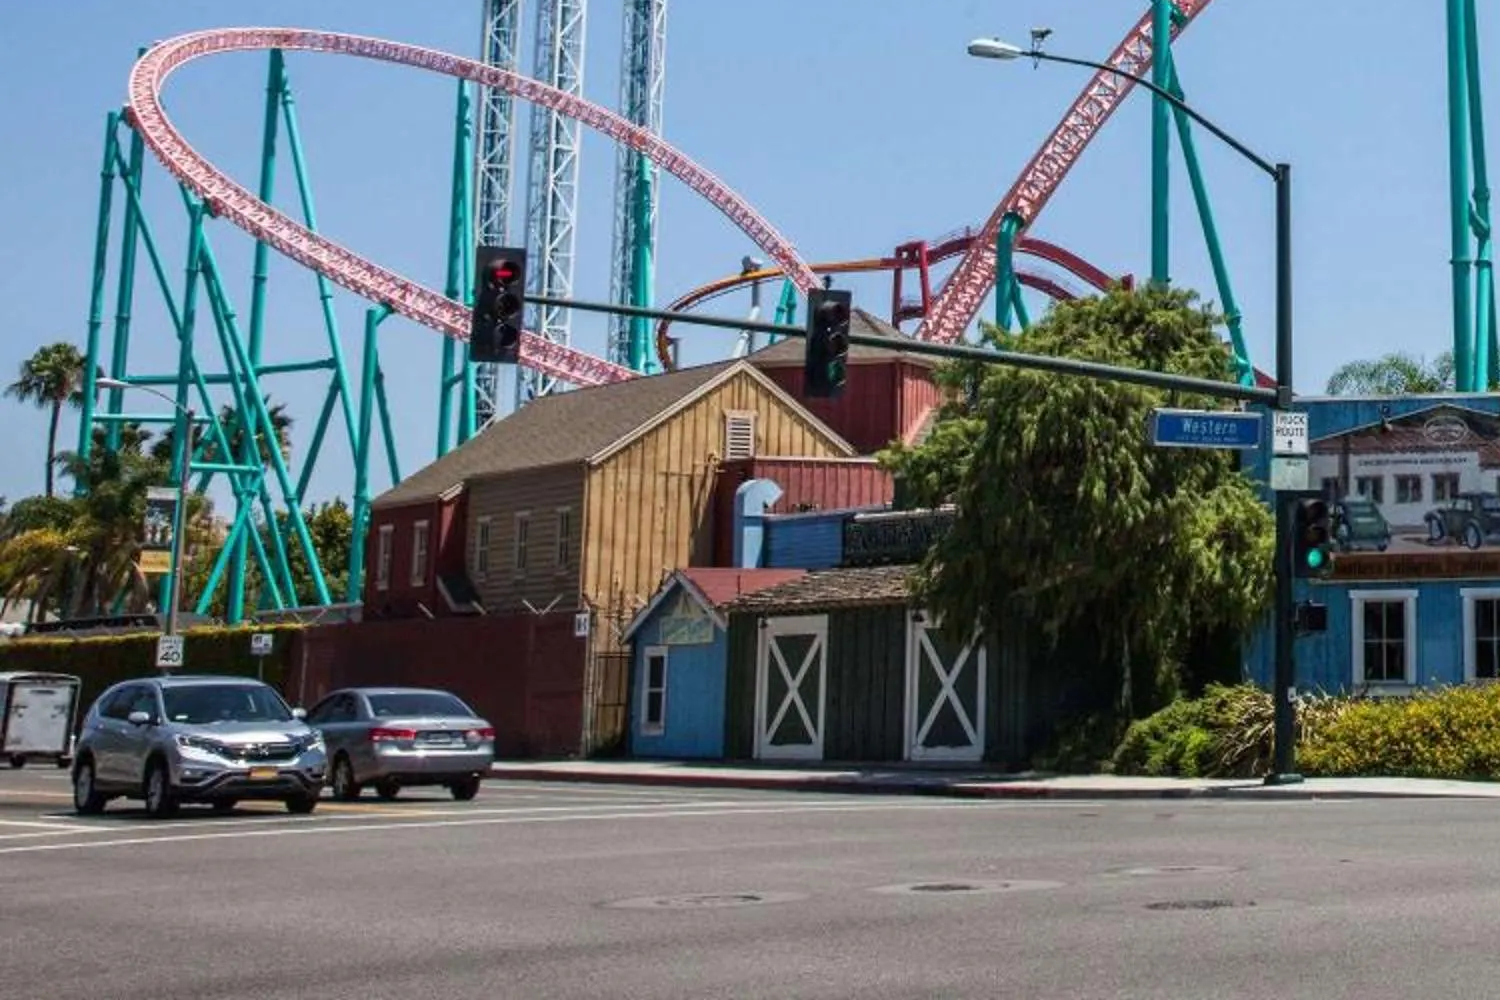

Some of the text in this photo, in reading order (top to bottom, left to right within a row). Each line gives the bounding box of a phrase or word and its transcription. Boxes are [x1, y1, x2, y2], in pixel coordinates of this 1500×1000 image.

[1275, 415, 1305, 425] TRUCK
[1181, 417, 1238, 435] Western
[1275, 427, 1305, 437] ROUTE
[159, 651, 181, 662] 40
